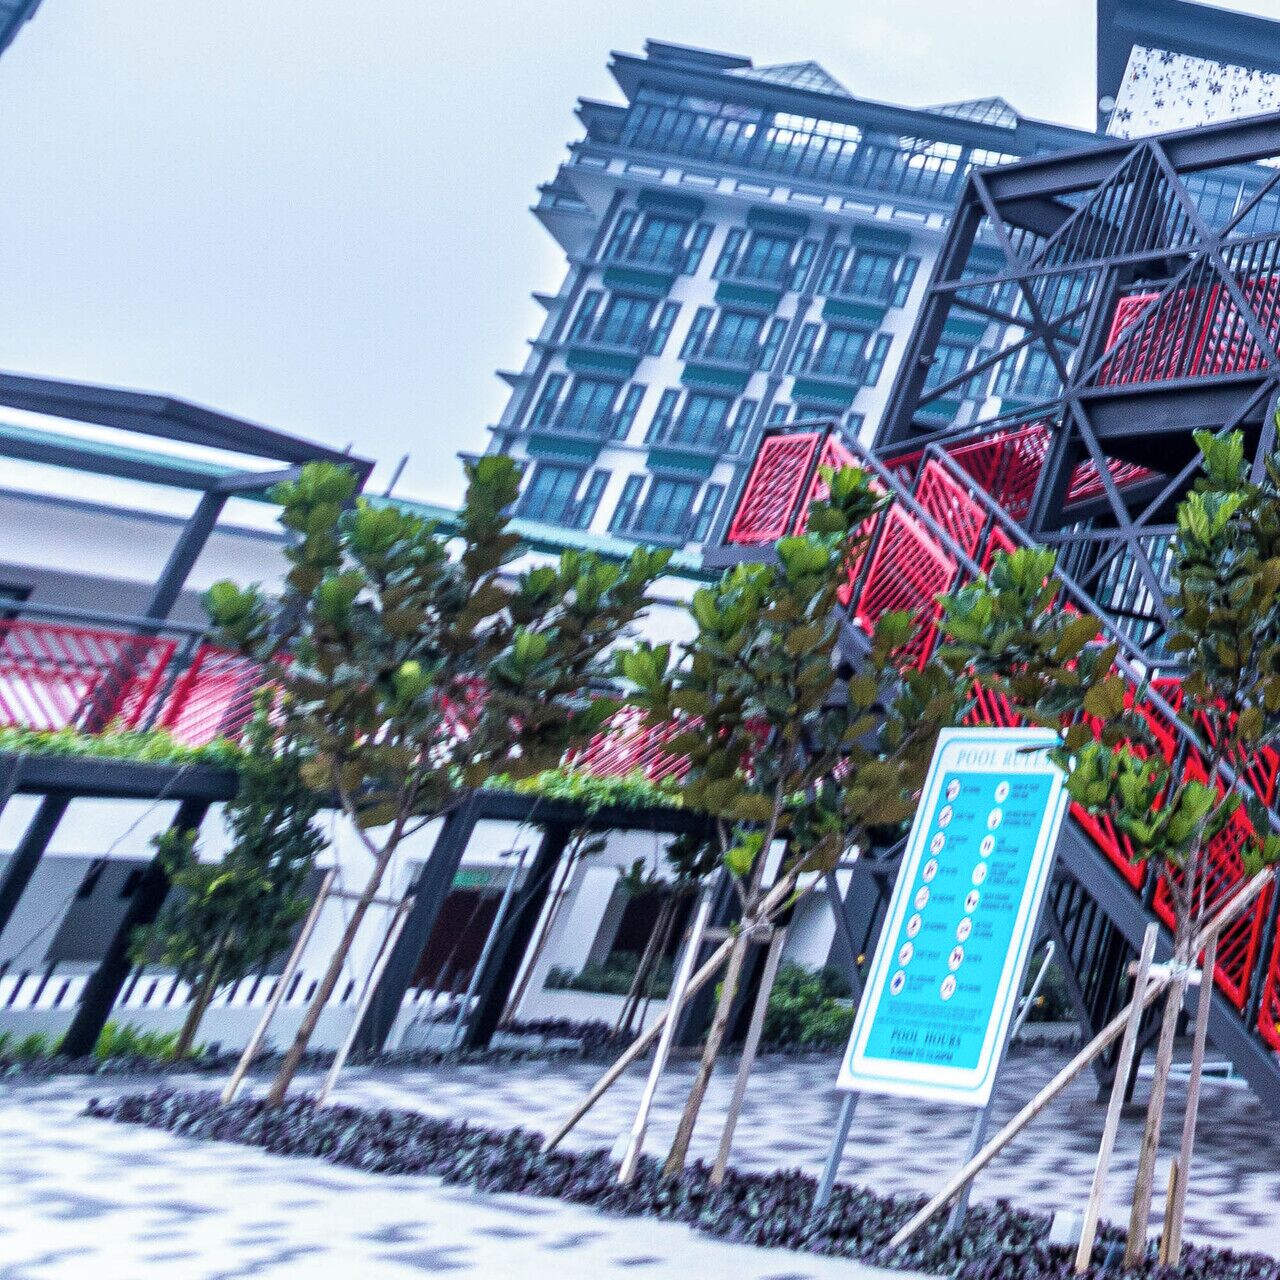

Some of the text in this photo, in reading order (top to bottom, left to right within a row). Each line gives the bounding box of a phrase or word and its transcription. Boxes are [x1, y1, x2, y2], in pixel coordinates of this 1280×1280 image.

[956, 749, 996, 767] POOL
[890, 1028, 961, 1048] POOL HOURS
